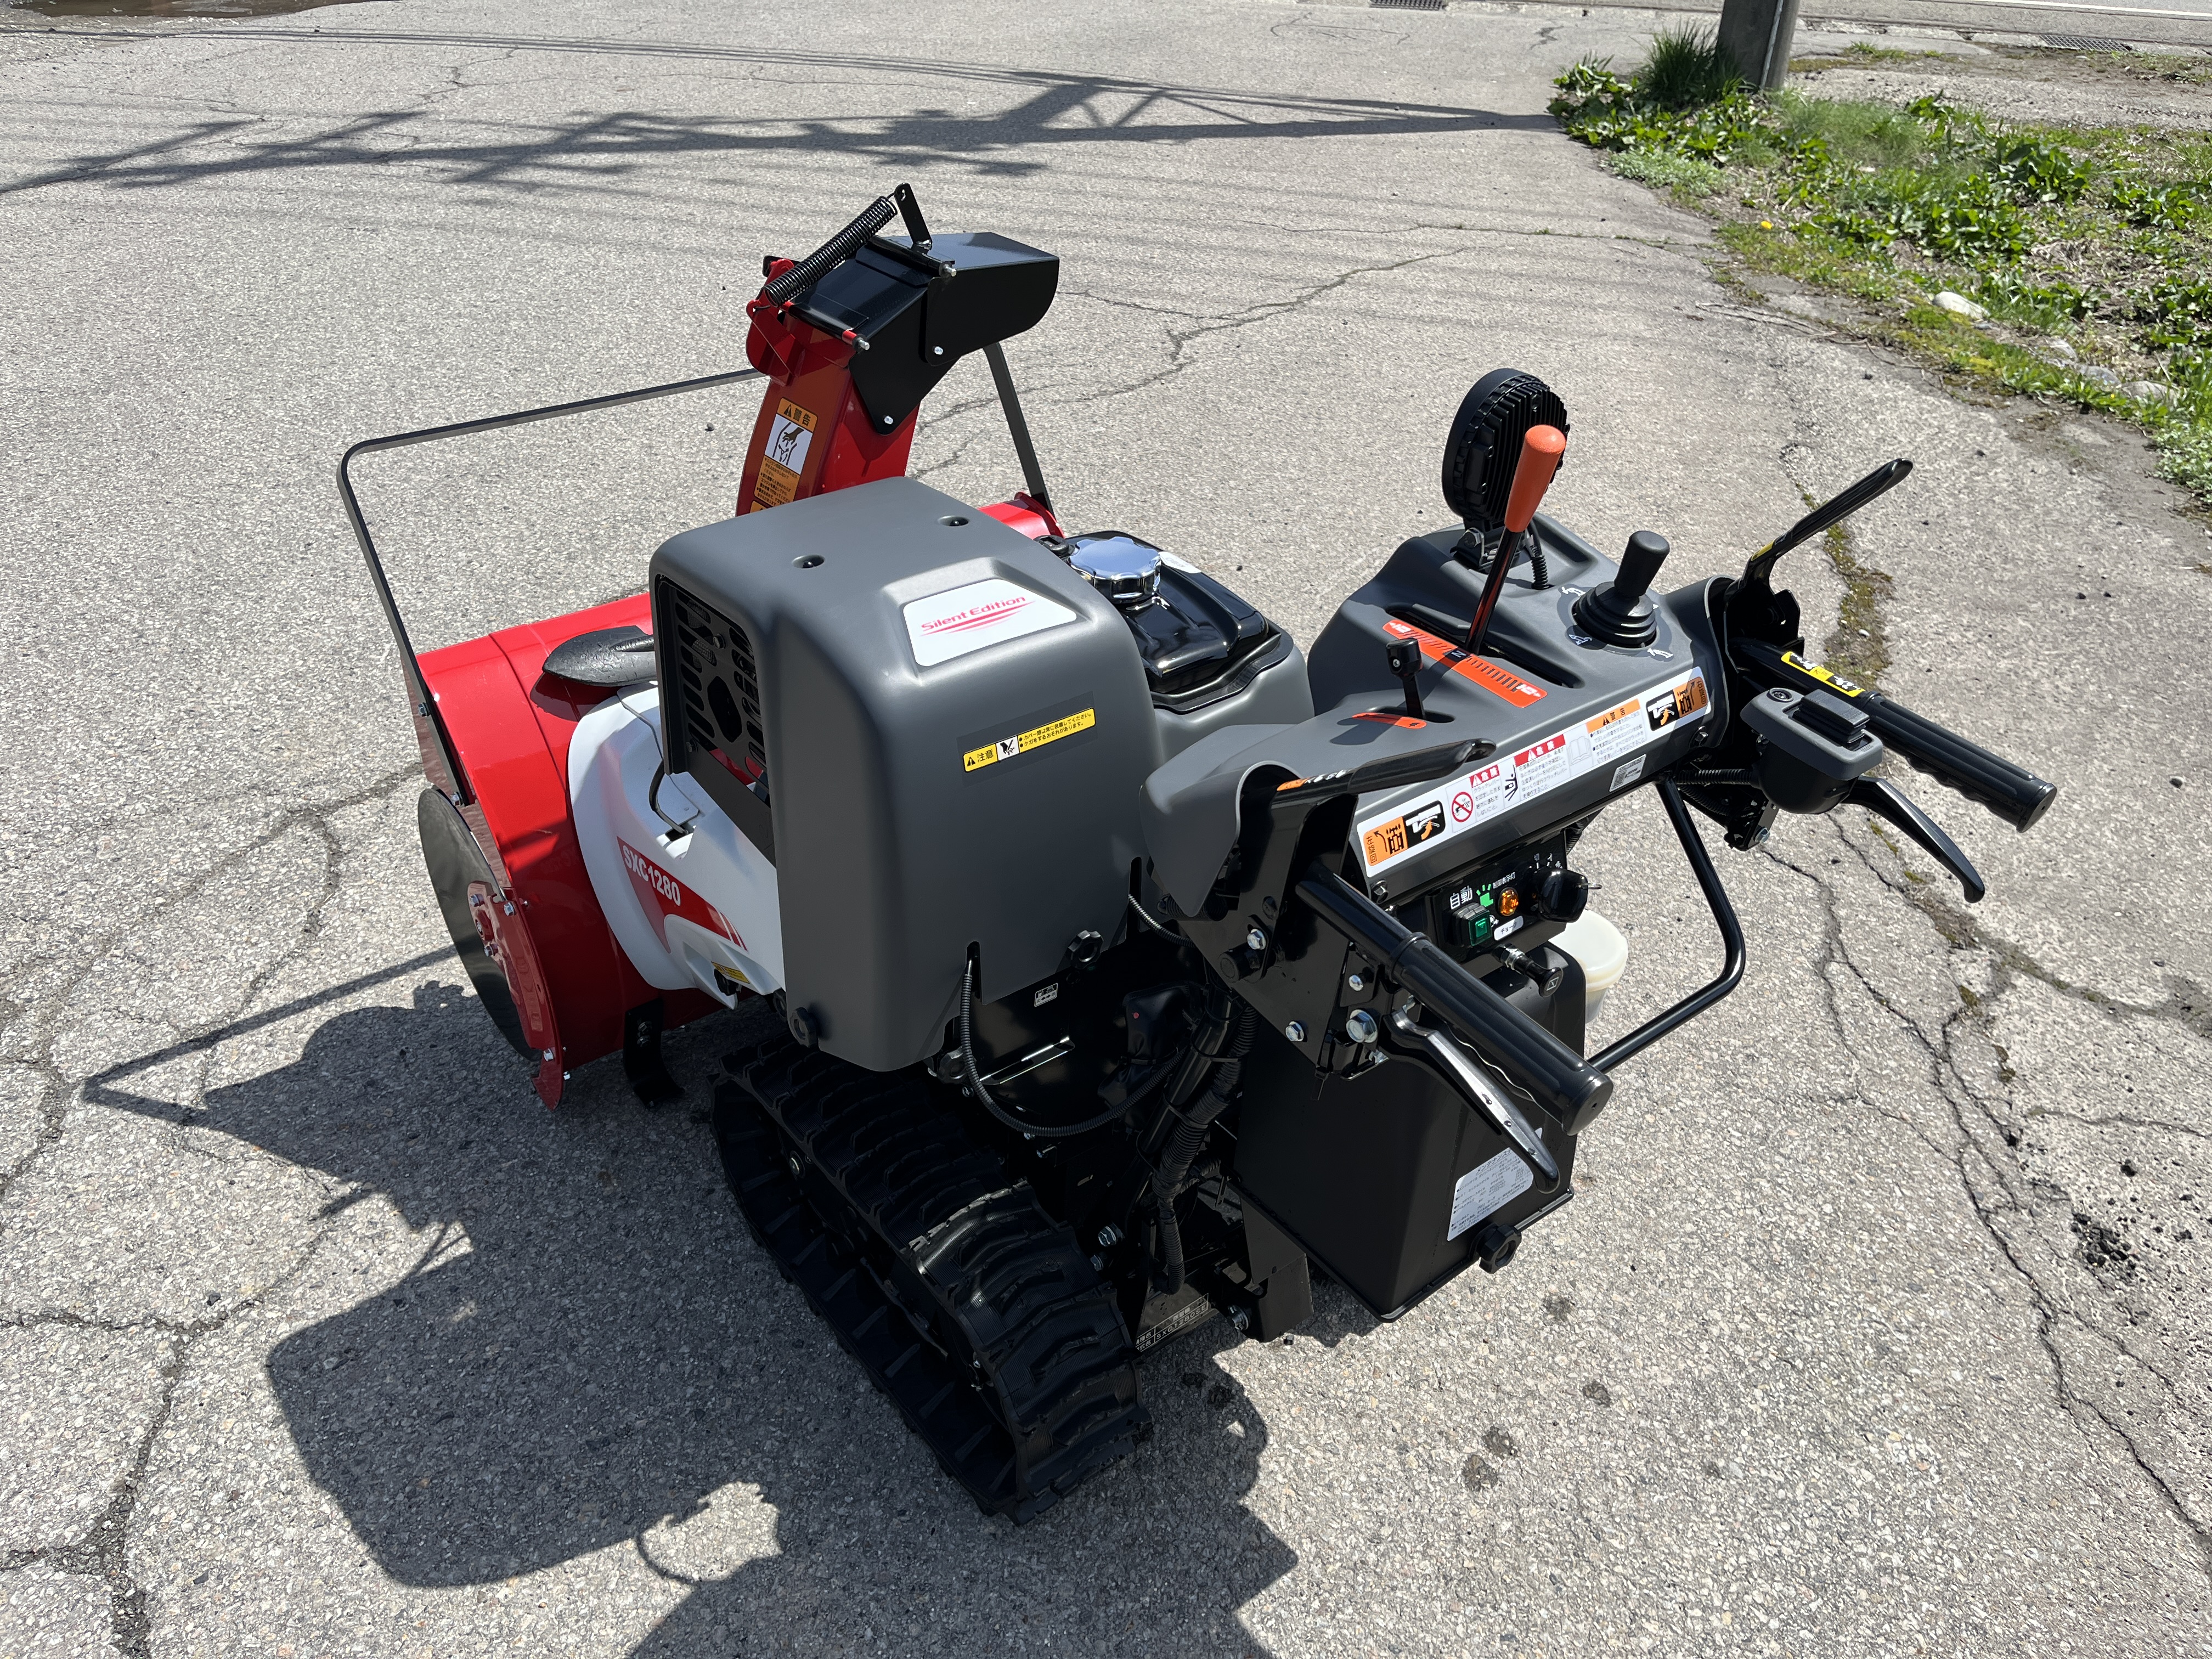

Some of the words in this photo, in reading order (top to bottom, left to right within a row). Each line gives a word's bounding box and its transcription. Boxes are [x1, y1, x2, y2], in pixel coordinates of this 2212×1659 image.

[793, 408, 811, 427] 警告
[921, 611, 968, 632] Silent
[969, 596, 1026, 616] Edition
[1451, 650, 1467, 658] N
[1610, 708, 1626, 721] 警告
[1023, 713, 1092, 741] カバー類は常に装着してください。
[1024, 722, 1084, 747] ケガをするおそれがあります。
[977, 749, 994, 763] 注意
[1536, 740, 1555, 756] 危険
[1480, 766, 1499, 782] 危険
[1365, 835, 1378, 864] 左旋回
[622, 844, 681, 906] SXC1280
[1449, 885, 1474, 910] 自動
[1500, 921, 1517, 935] チョーク
[1156, 1304, 1207, 1340] SXC1280SE
[1172, 1306, 1191, 1322] 除雪機
